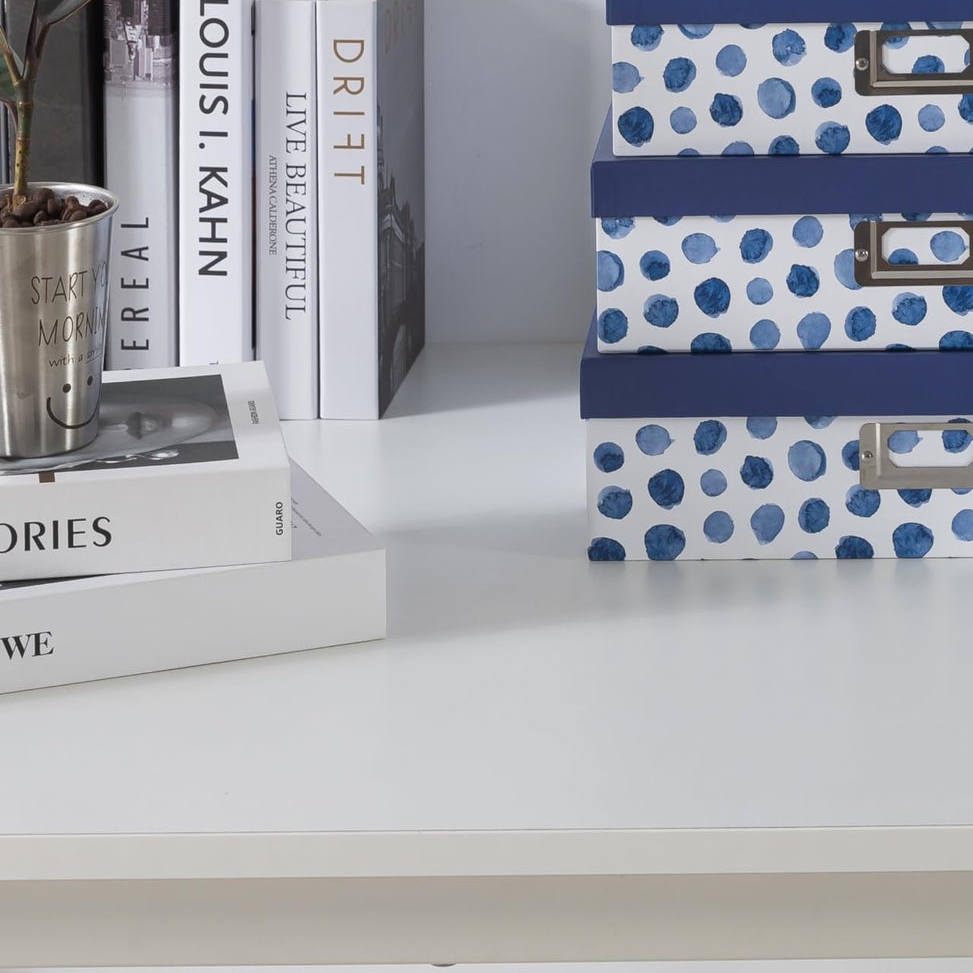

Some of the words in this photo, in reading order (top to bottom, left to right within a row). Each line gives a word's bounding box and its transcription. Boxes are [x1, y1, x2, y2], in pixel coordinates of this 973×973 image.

[285, 91, 307, 154] LIVE
[333, 39, 365, 185] DRIFT
[199, 131, 229, 150] I.
[269, 154, 277, 195] ATHENA
[198, 166, 229, 277] KAHN
[269, 196, 277, 256] CALDERONE
[285, 163, 306, 321] BEAUTIFUL
[31, 270, 88, 305] START
[121, 217, 150, 371] EREAL
[49, 353, 75, 367] with
[0, 516, 112, 554] ORIES
[275, 501, 284, 536] GUARO
[0, 631, 54, 660] WE
